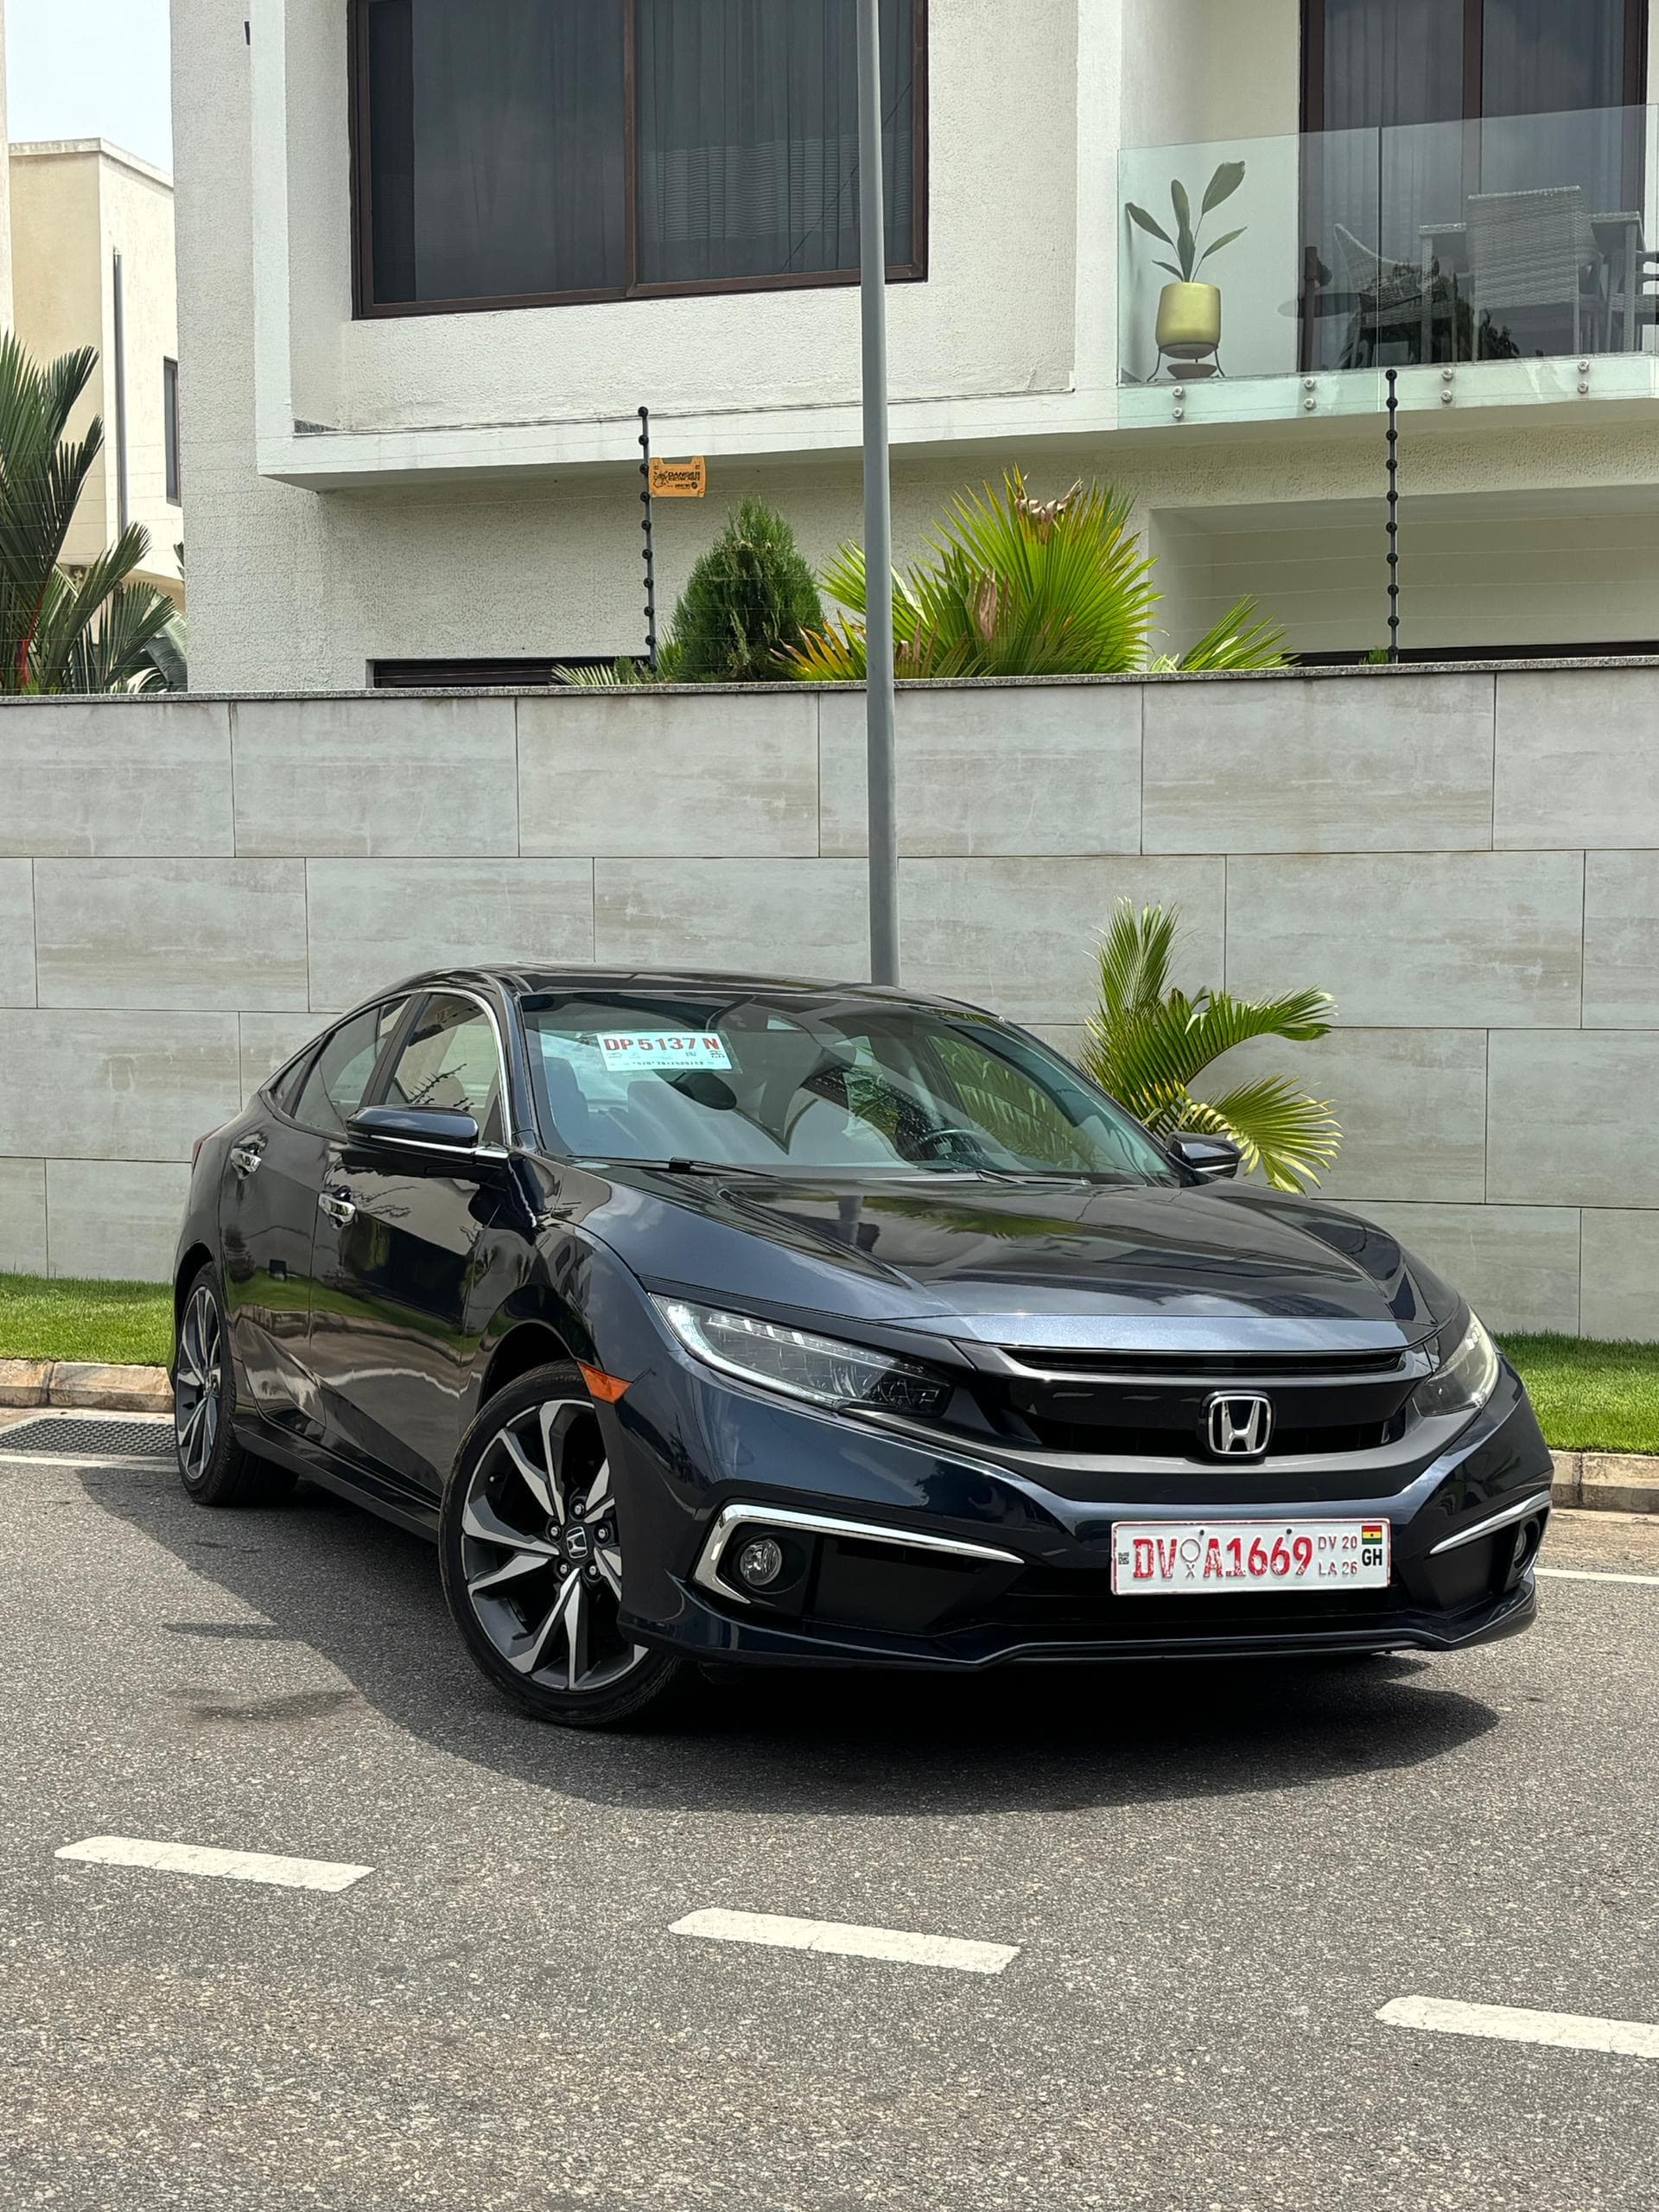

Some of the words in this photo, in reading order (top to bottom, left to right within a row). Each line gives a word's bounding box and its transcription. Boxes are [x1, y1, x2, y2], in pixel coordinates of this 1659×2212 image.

[638, 1037, 696, 1052] 5137
[702, 1037, 721, 1051] N
[1318, 1535, 1337, 1550] DV
[1342, 1535, 1357, 1549] 20
[1362, 1548, 1382, 1567] GH
[1318, 1561, 1338, 1576] LA
[1342, 1561, 1357, 1575] 26
